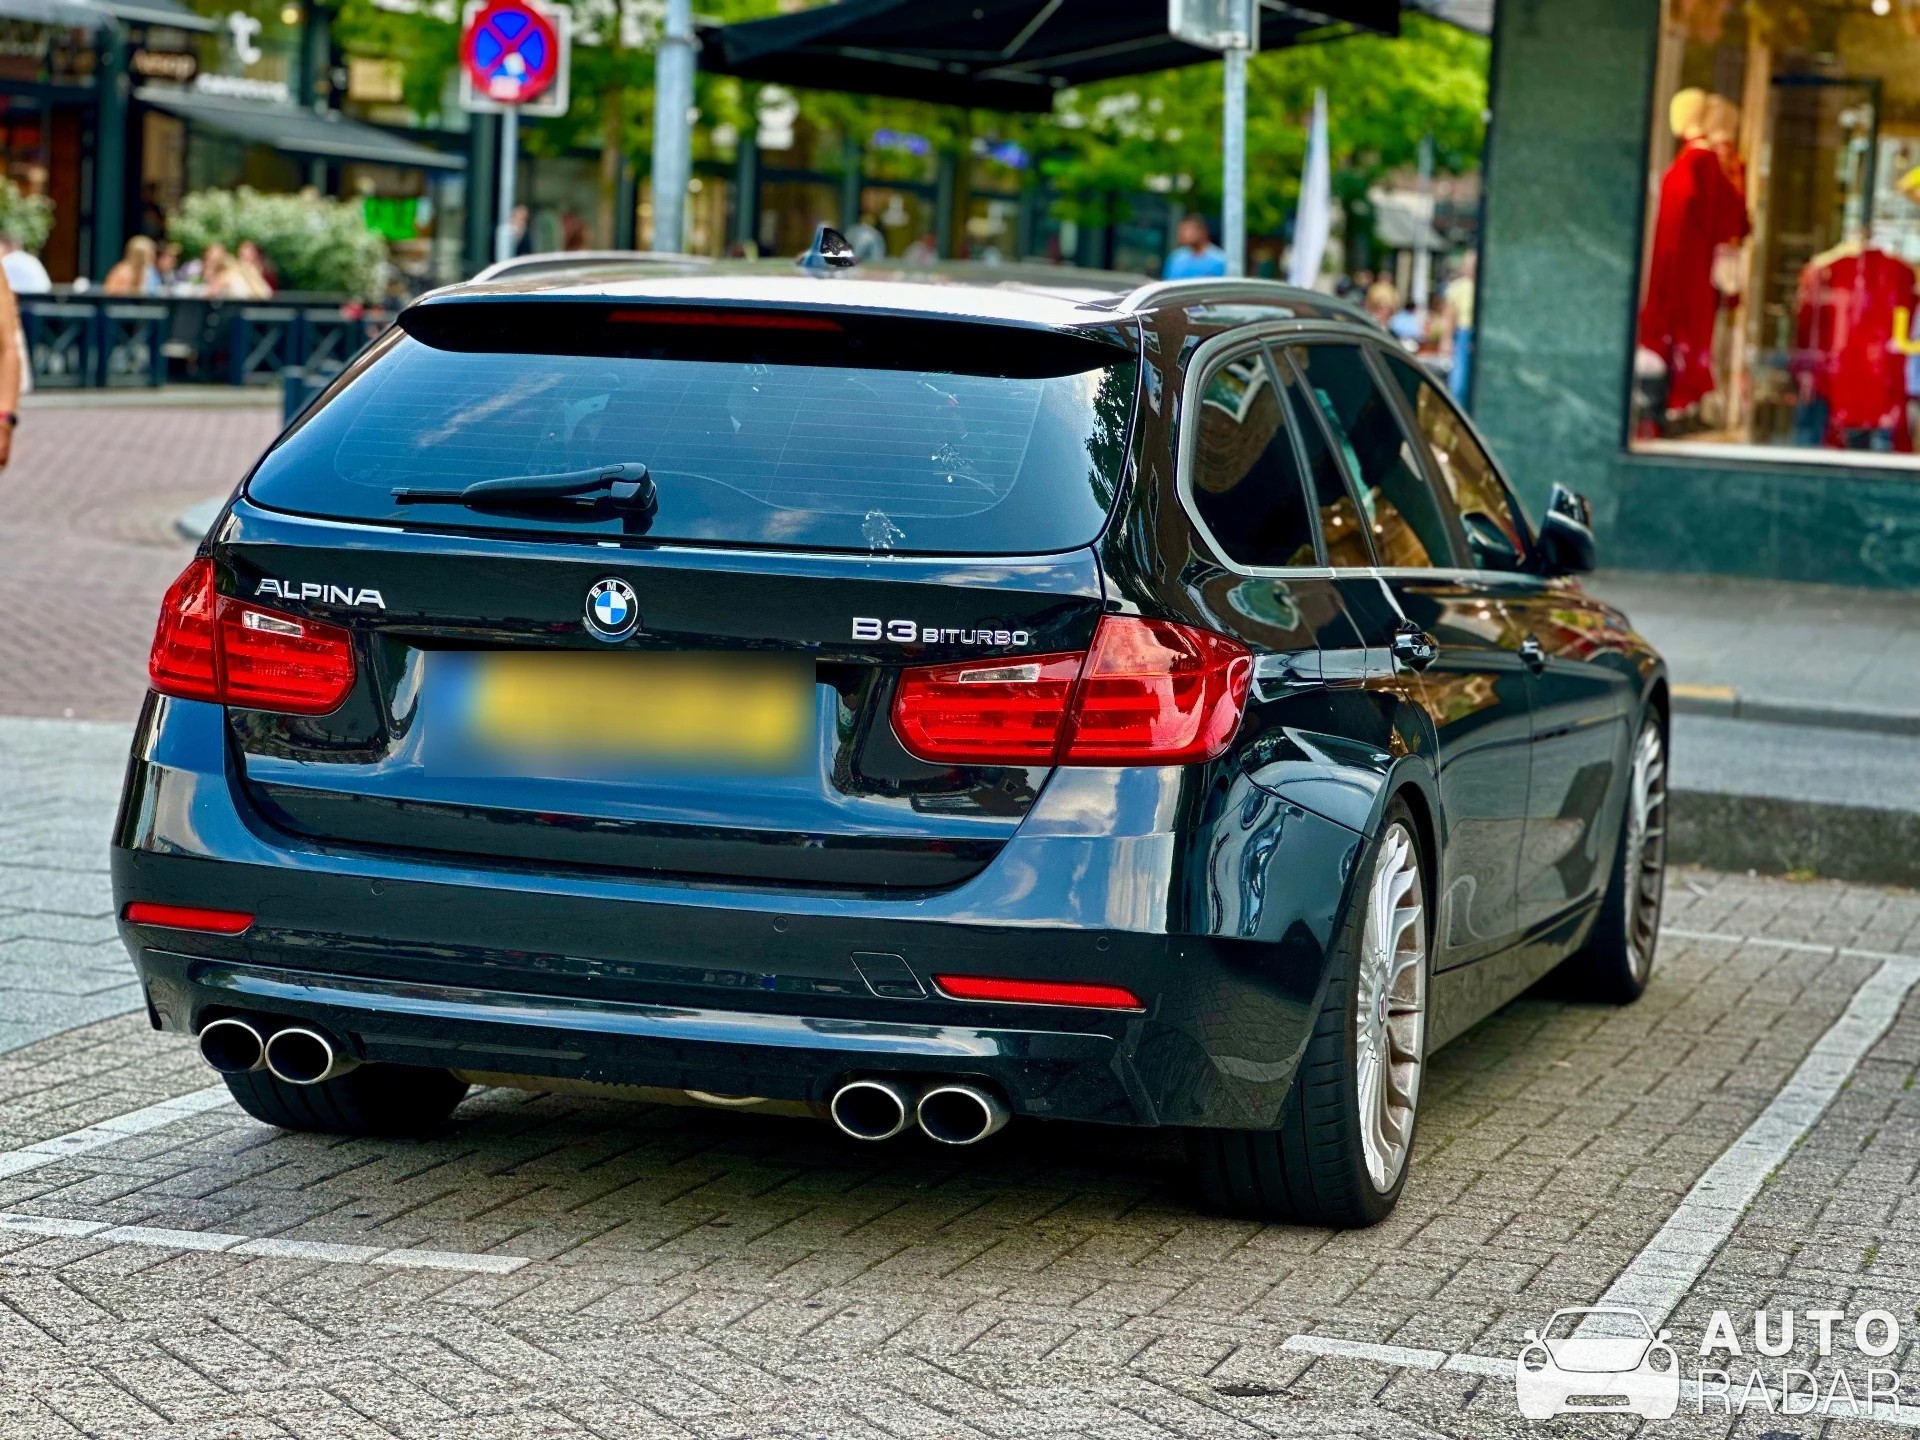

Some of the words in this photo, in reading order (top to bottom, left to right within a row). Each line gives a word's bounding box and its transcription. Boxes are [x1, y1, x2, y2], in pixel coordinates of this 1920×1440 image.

[254, 578, 386, 609] ALPINA
[590, 581, 634, 601] BMW
[852, 617, 917, 643] B3
[922, 628, 1029, 646] BITURBO
